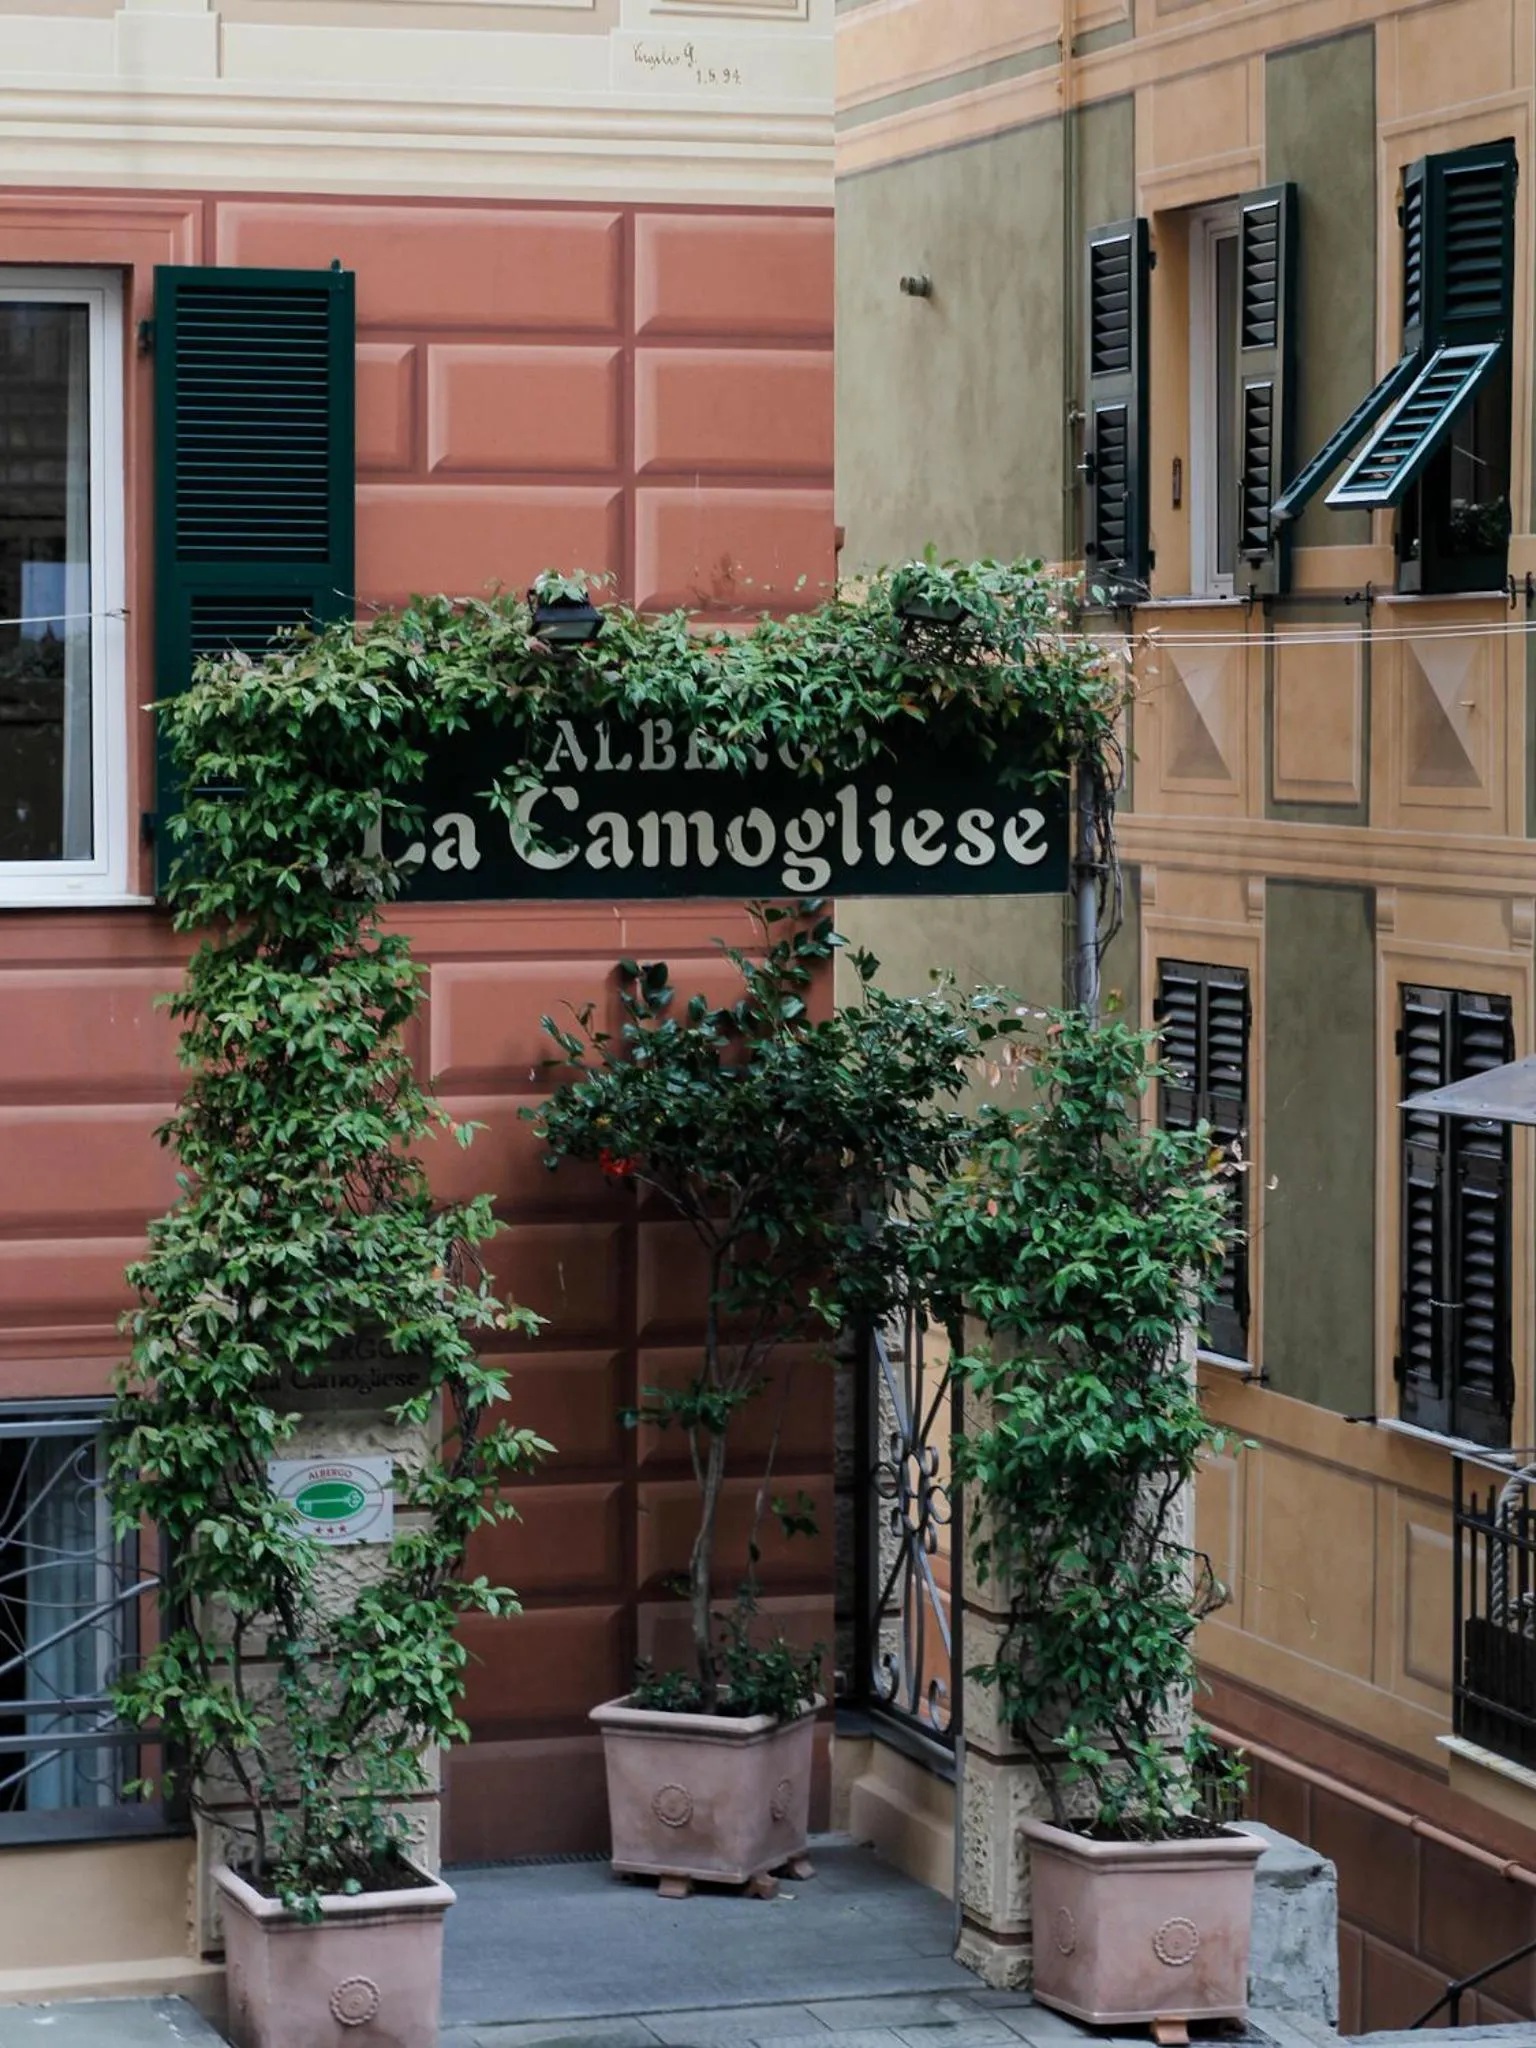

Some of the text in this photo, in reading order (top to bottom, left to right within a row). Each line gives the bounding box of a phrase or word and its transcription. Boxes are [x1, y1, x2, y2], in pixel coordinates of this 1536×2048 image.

[363, 784, 1048, 892] La Camogliese
[308, 1468, 353, 1481] ALBERGO
